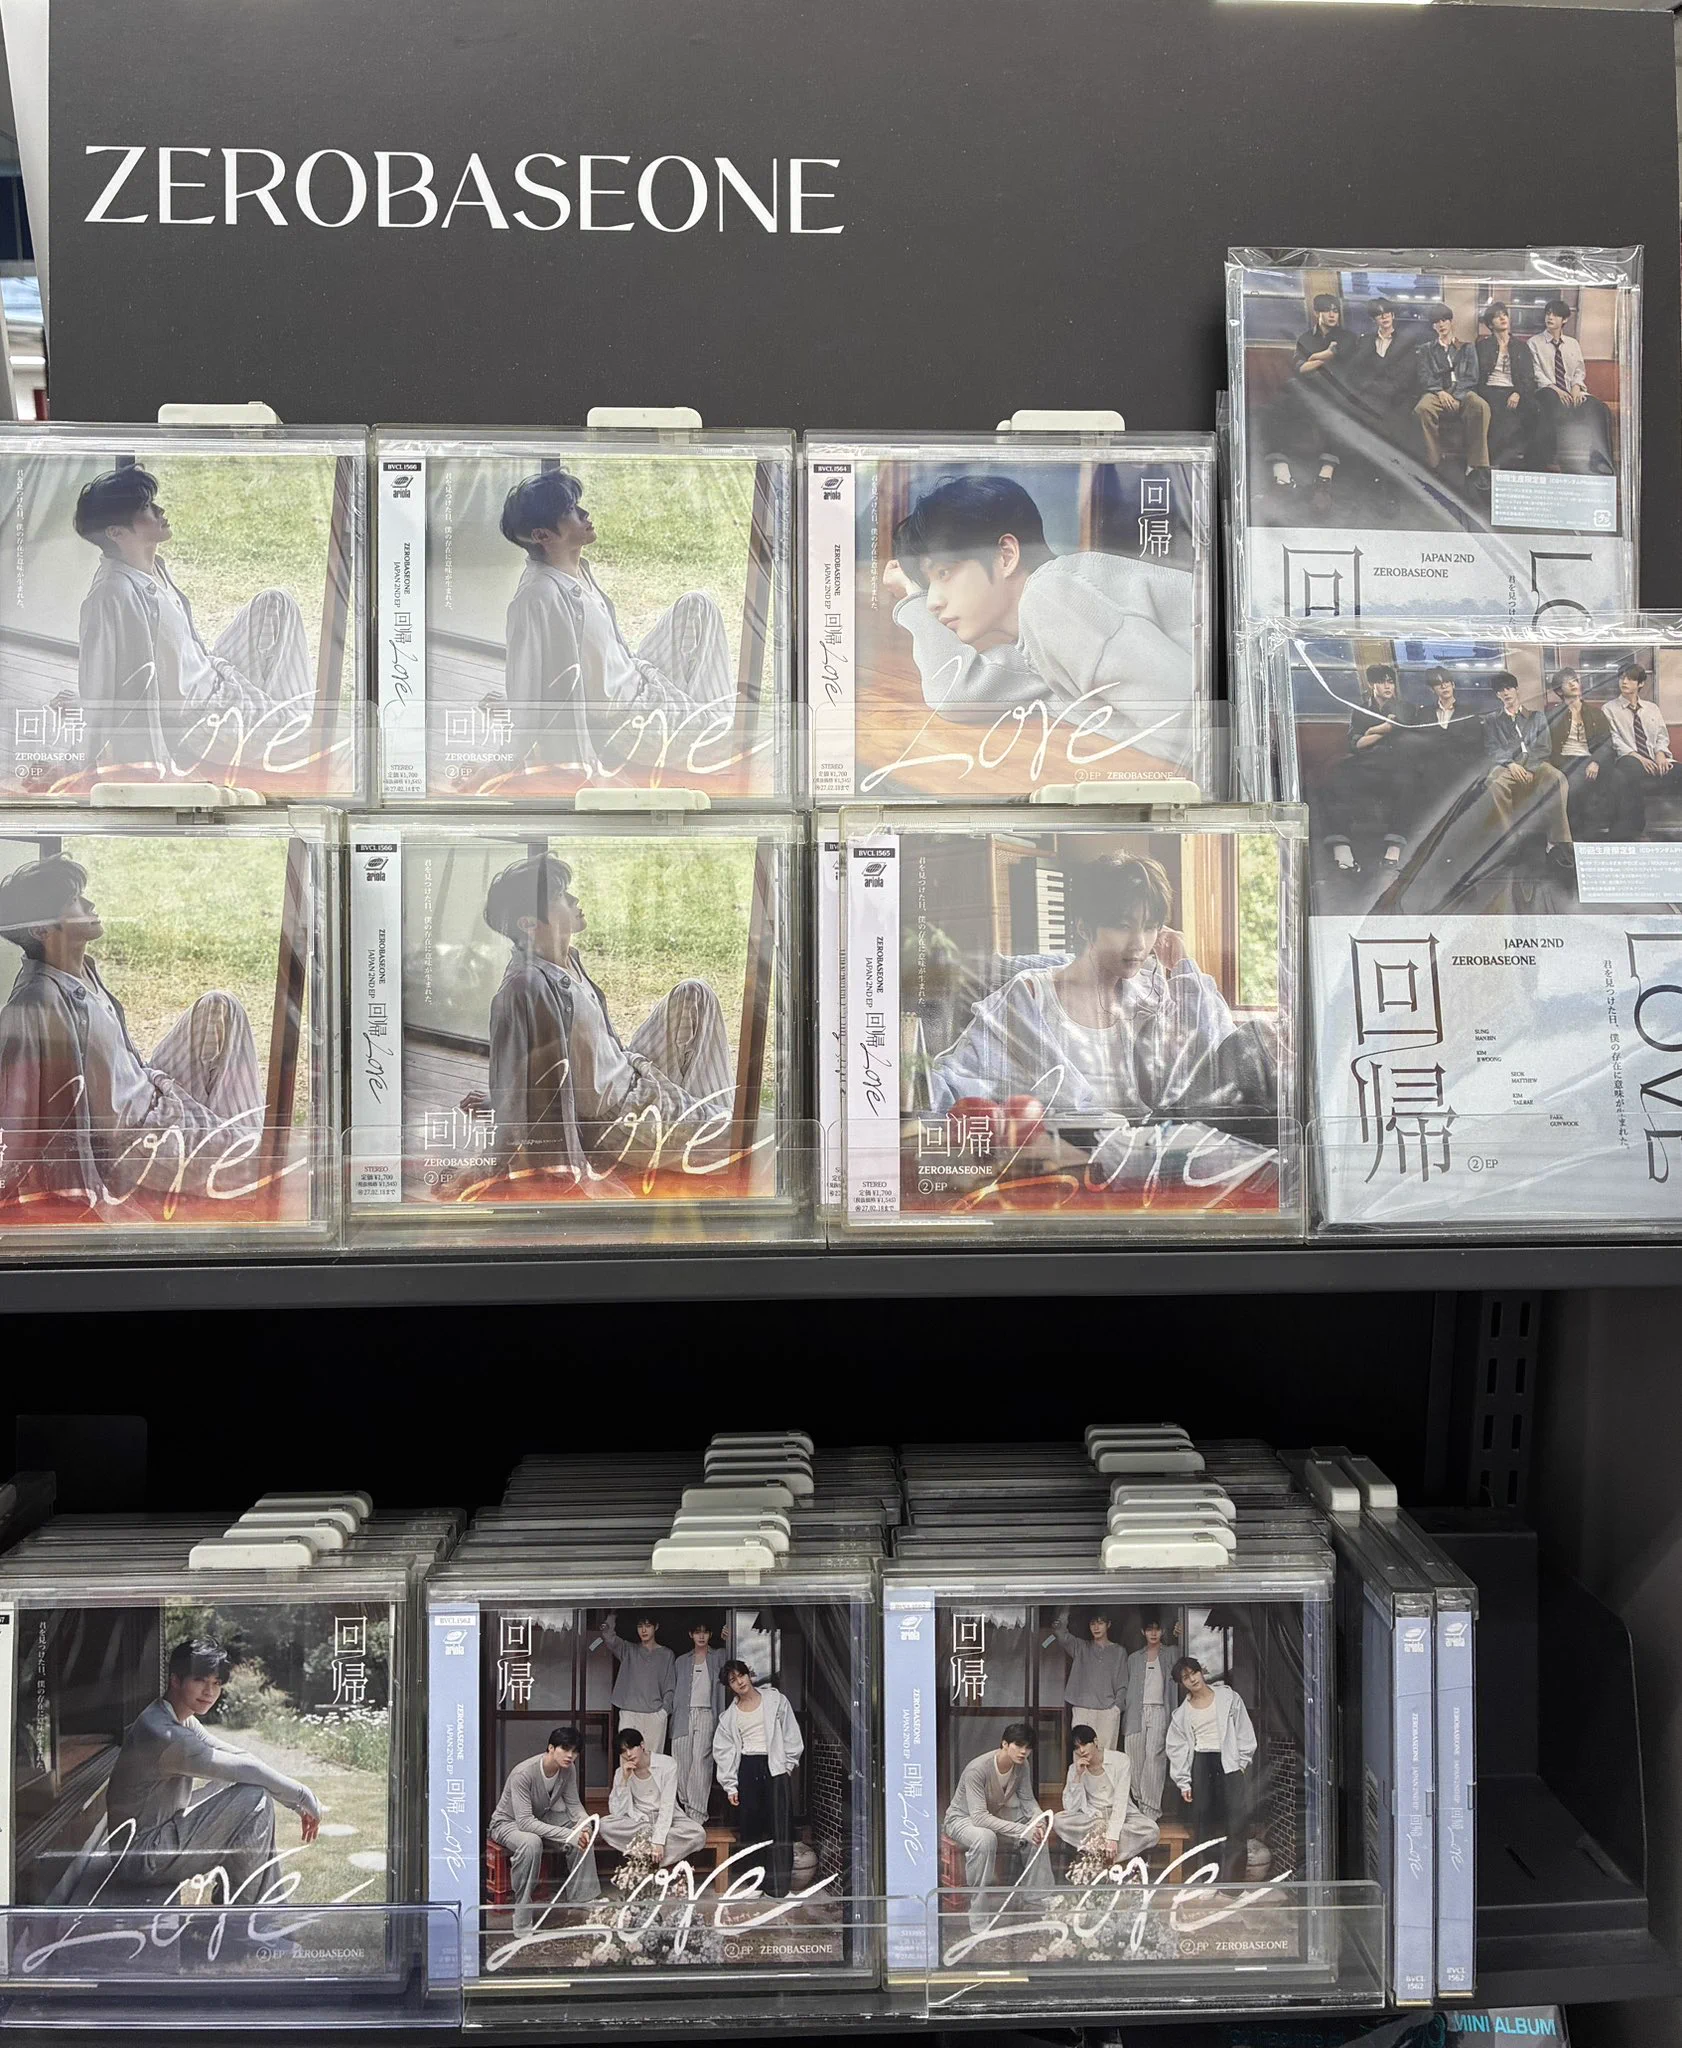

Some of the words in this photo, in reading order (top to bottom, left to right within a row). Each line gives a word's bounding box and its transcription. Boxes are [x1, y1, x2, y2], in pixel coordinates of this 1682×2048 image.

[84, 145, 845, 234] ZEROBASEONE
[1137, 476, 1172, 558] 回帰
[403, 542, 411, 595] ZEROBASEONE
[824, 563, 832, 584] JAPAN
[1373, 567, 1449, 579] ZEROBASEONE
[1420, 552, 1453, 564] JAPAN
[1453, 553, 1475, 564] 2ND
[14, 705, 88, 746] 回帰
[444, 707, 516, 747] 回帰
[860, 655, 1181, 793] Love
[14, 751, 86, 762] ZEROBASEONE
[444, 752, 514, 762] ZEROBASEONE
[1106, 771, 1174, 780] ZEROBASEONE
[378, 928, 386, 985] ZEROBASEONE
[1503, 937, 1539, 949] JAPAN
[1540, 938, 1564, 949] 2ND
[368, 949, 376, 971] JAPAN
[865, 957, 873, 980] JAPAN
[876, 936, 884, 994] ZEROBASEONE
[1452, 955, 1537, 967] ZEROBASEONE
[1348, 932, 1460, 1184] 回帰
[424, 1107, 499, 1150] 回帰
[917, 1112, 994, 1158] 回帰
[424, 1157, 498, 1167] ZEROBASEONE
[918, 1165, 993, 1175] ZEROBASEONE
[1485, 1159, 1499, 1169] EP
[331, 1615, 369, 1705] 回帰
[496, 1615, 536, 1705] 回帰
[950, 1613, 988, 1701] 回帰
[456, 1703, 465, 1760] ZEROBASEONE
[912, 1688, 921, 1744] ZEROBASEONE
[22, 1818, 375, 1973] Love
[486, 1813, 840, 1972] Love
[943, 1809, 1293, 1968] Love
[292, 1947, 365, 1958] ZEROBASEONE
[760, 1944, 833, 1955] ZEROBASEONE
[1215, 1940, 1289, 1951] ZEROBASEONE
[1407, 1982, 1424, 1990] 1562
[1448, 1974, 1465, 1982] 1562
[1451, 2012, 1491, 2034] MINI
[1494, 2016, 1557, 2037] ALBUM
